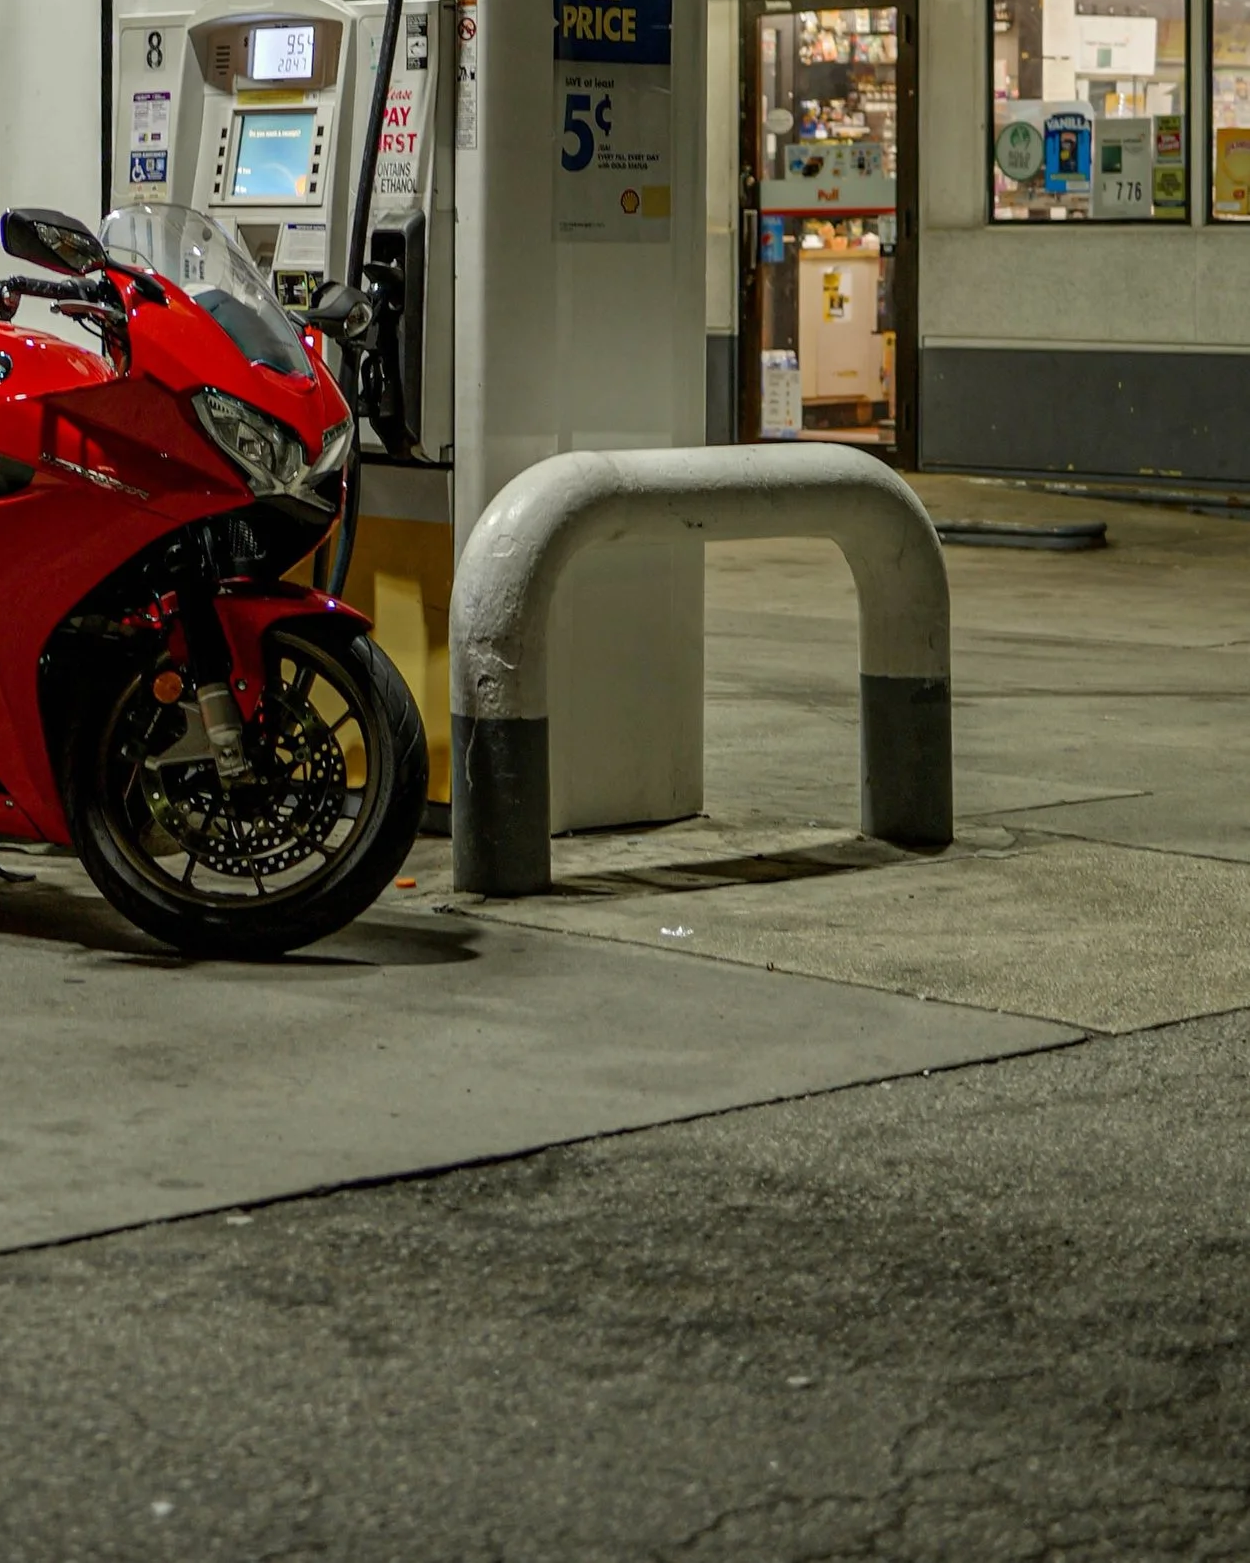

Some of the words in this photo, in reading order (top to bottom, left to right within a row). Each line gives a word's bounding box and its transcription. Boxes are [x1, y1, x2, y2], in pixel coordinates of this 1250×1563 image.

[563, 5, 637, 42] PRICE
[146, 30, 163, 70] 8
[1046, 117, 1091, 132] VANILLA
[377, 162, 411, 178] ONTAINS
